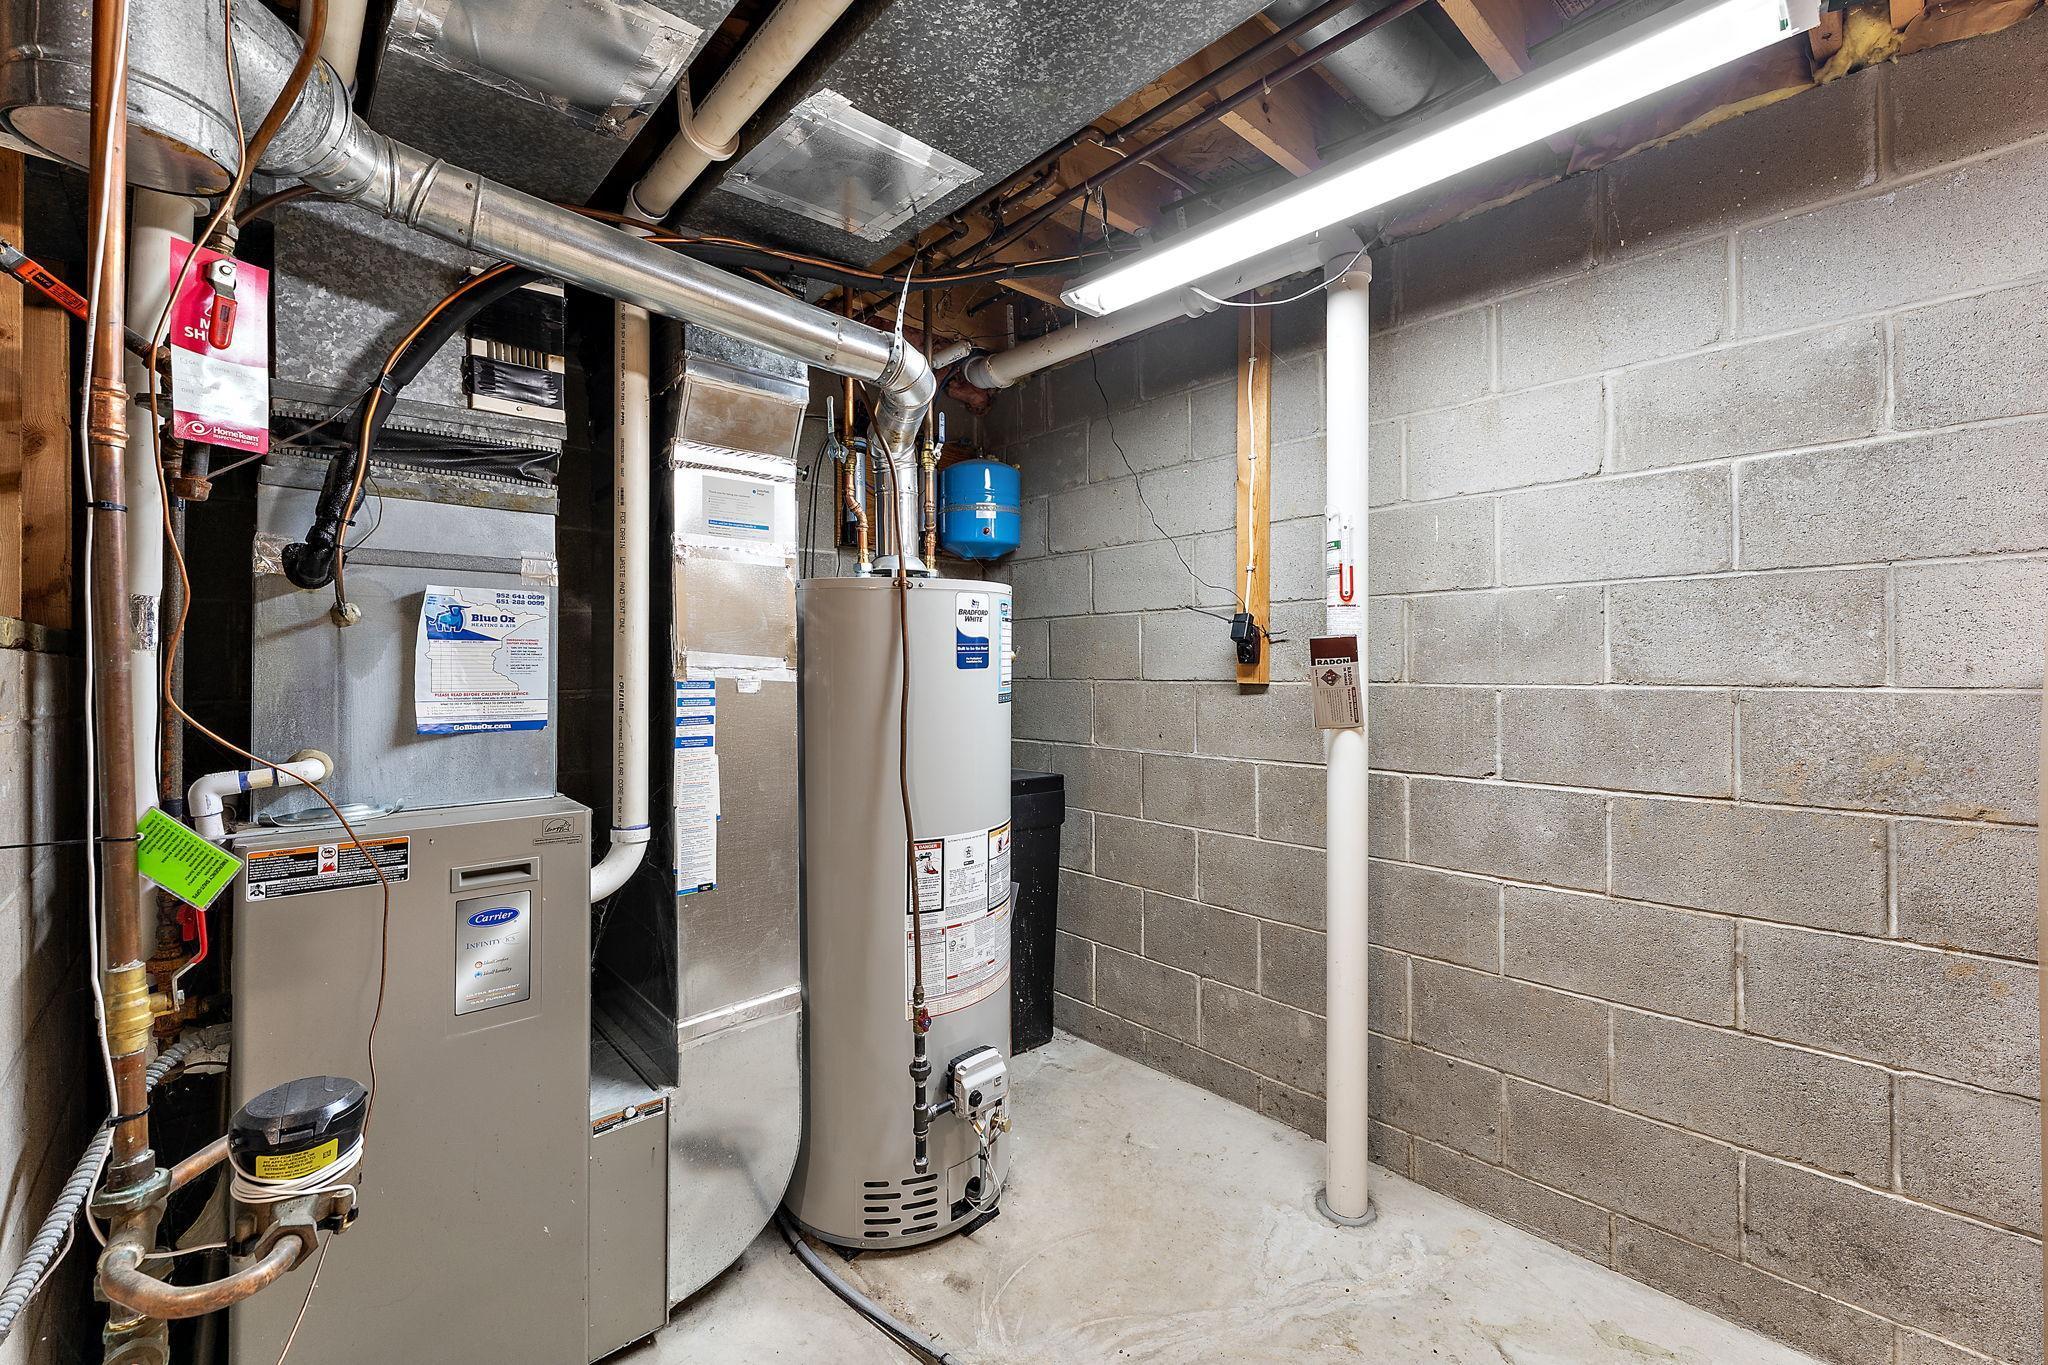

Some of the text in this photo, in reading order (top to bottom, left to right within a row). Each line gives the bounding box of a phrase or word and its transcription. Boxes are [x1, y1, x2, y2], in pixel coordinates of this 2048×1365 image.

[213, 426, 259, 442] HomeTeam
[471, 614, 498, 622] Blue
[475, 911, 513, 923] Carrier
[466, 938, 501, 950] INFINITY
[488, 983, 520, 993] EFFICIENT
[486, 992, 515, 1001] FURNACE
